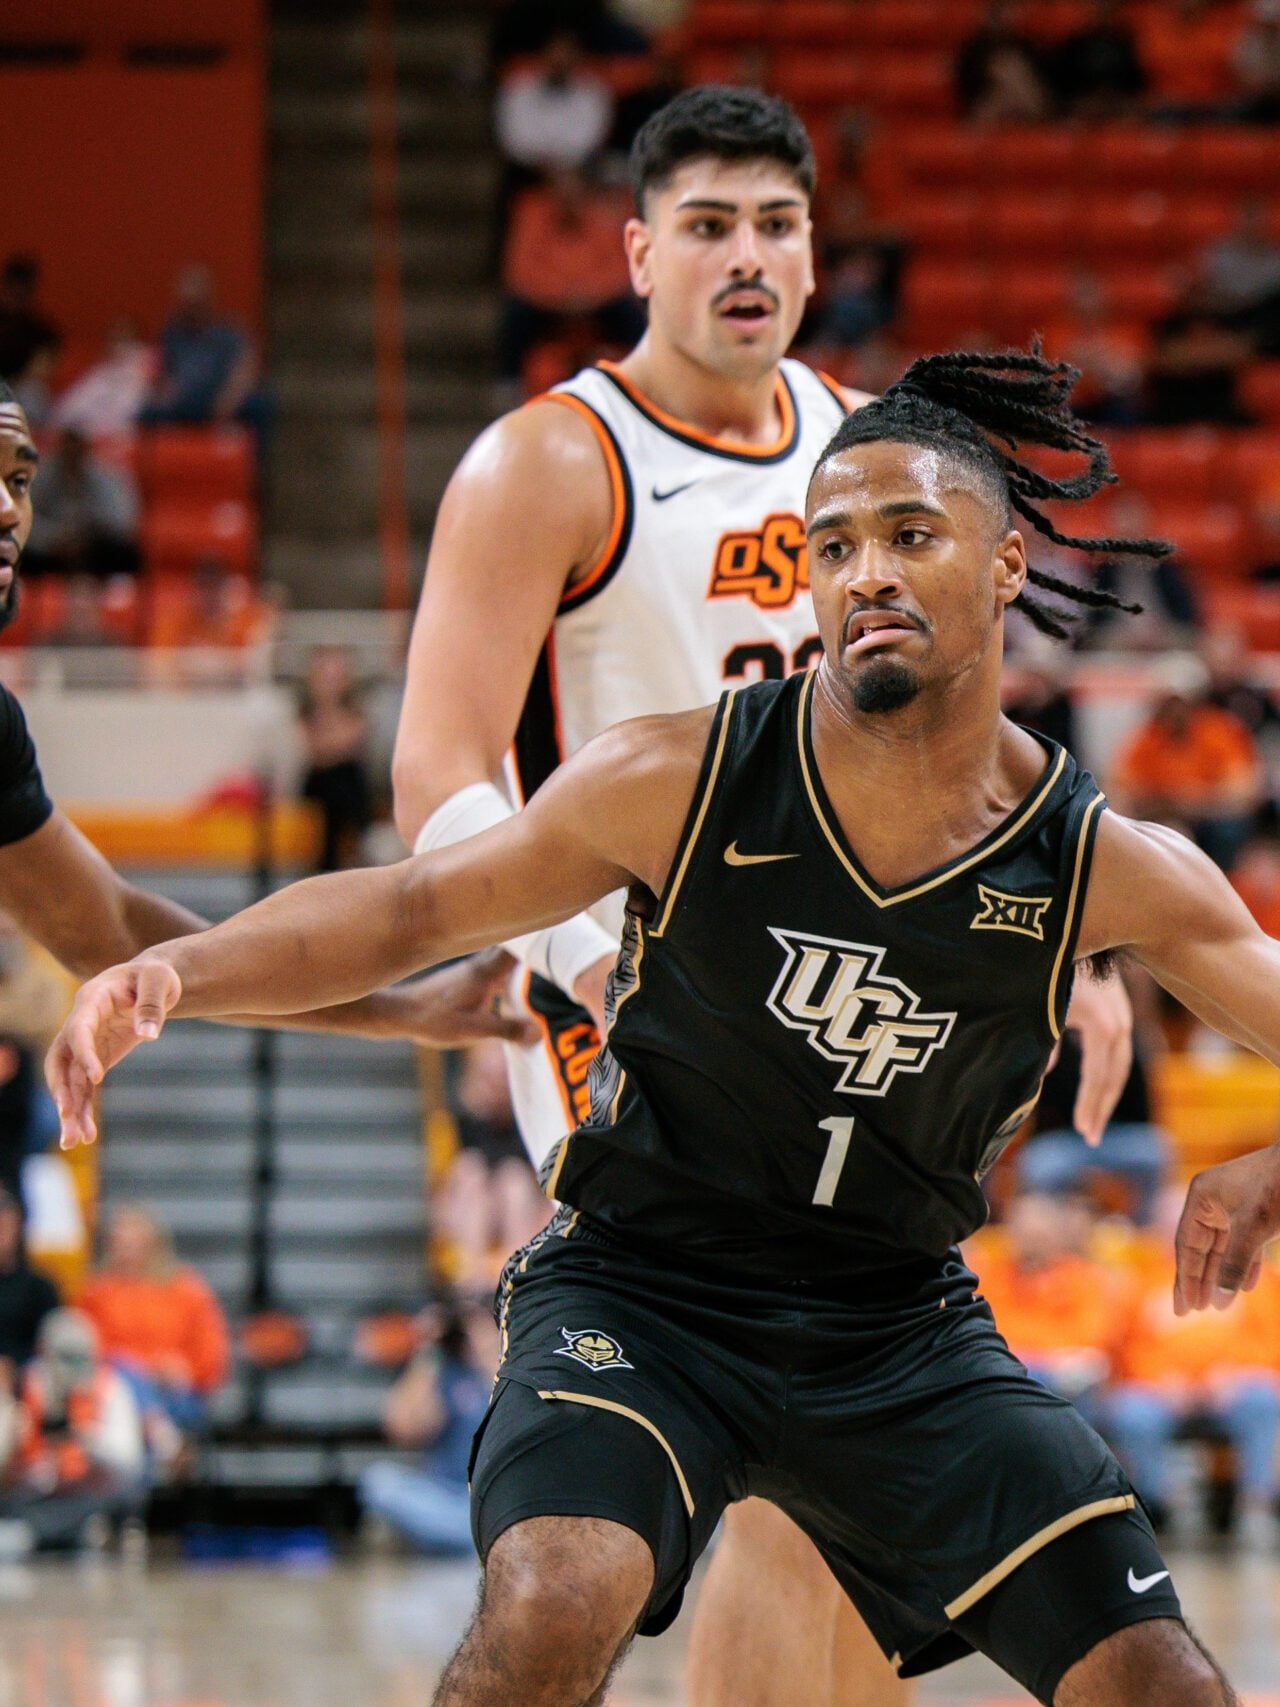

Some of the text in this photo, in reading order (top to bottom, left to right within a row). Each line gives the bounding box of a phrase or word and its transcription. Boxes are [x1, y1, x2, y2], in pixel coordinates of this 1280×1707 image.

[707, 513, 812, 611] OS
[974, 887, 1047, 938] XII
[774, 934, 950, 1091] UCF
[812, 1115, 855, 1207] 1
